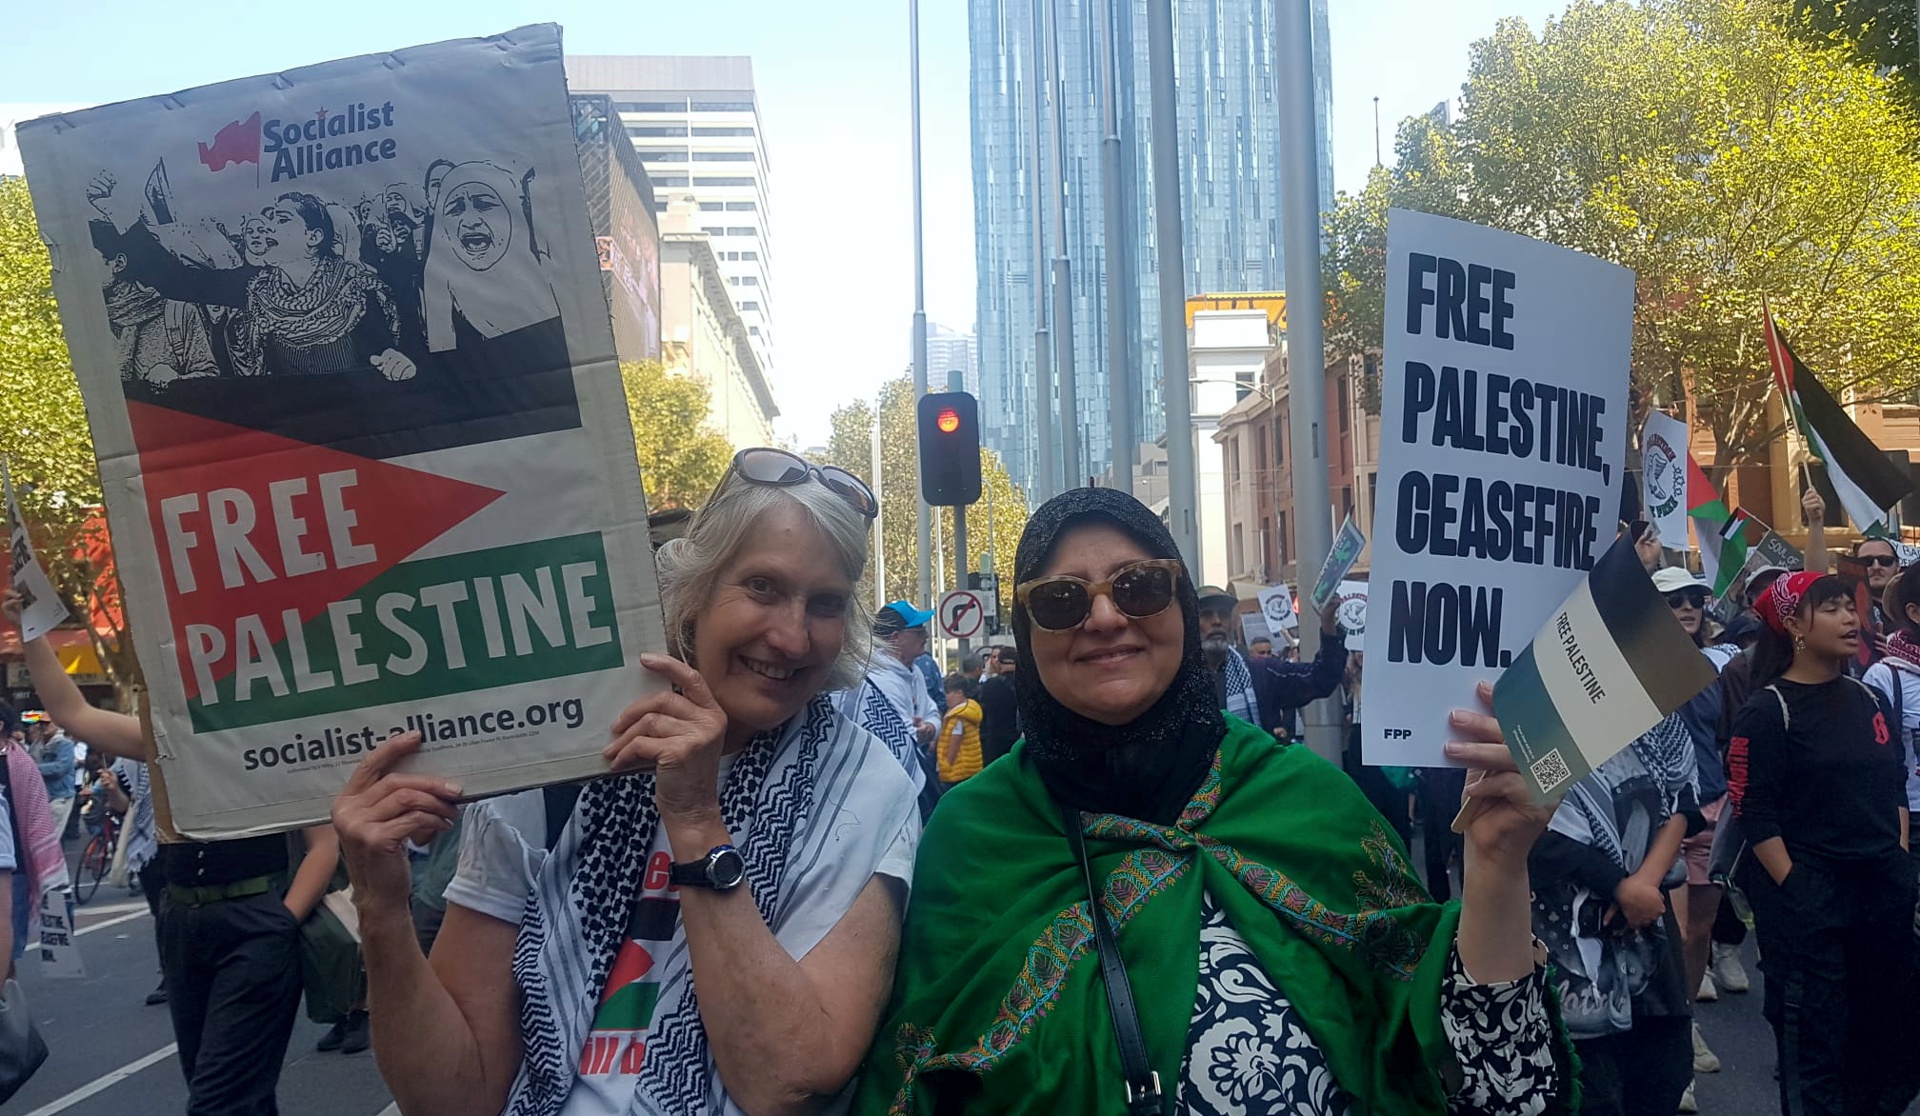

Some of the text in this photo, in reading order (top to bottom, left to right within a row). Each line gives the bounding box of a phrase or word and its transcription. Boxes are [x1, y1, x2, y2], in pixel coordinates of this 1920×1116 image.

[263, 101, 394, 152] Socialist
[270, 138, 396, 183] Alliance
[1406, 252, 1516, 351] FREE
[1402, 360, 1611, 487] PALESTINE,
[160, 468, 378, 595] FREE
[1395, 470, 1601, 572] CEASEFIRE
[1767, 538, 1799, 566] SOUL OF
[185, 560, 613, 707] PALESTINE
[1387, 580, 1512, 668] NOW.
[1556, 611, 1606, 704] FREE PALESTINE
[1384, 728, 1412, 740] FPP
